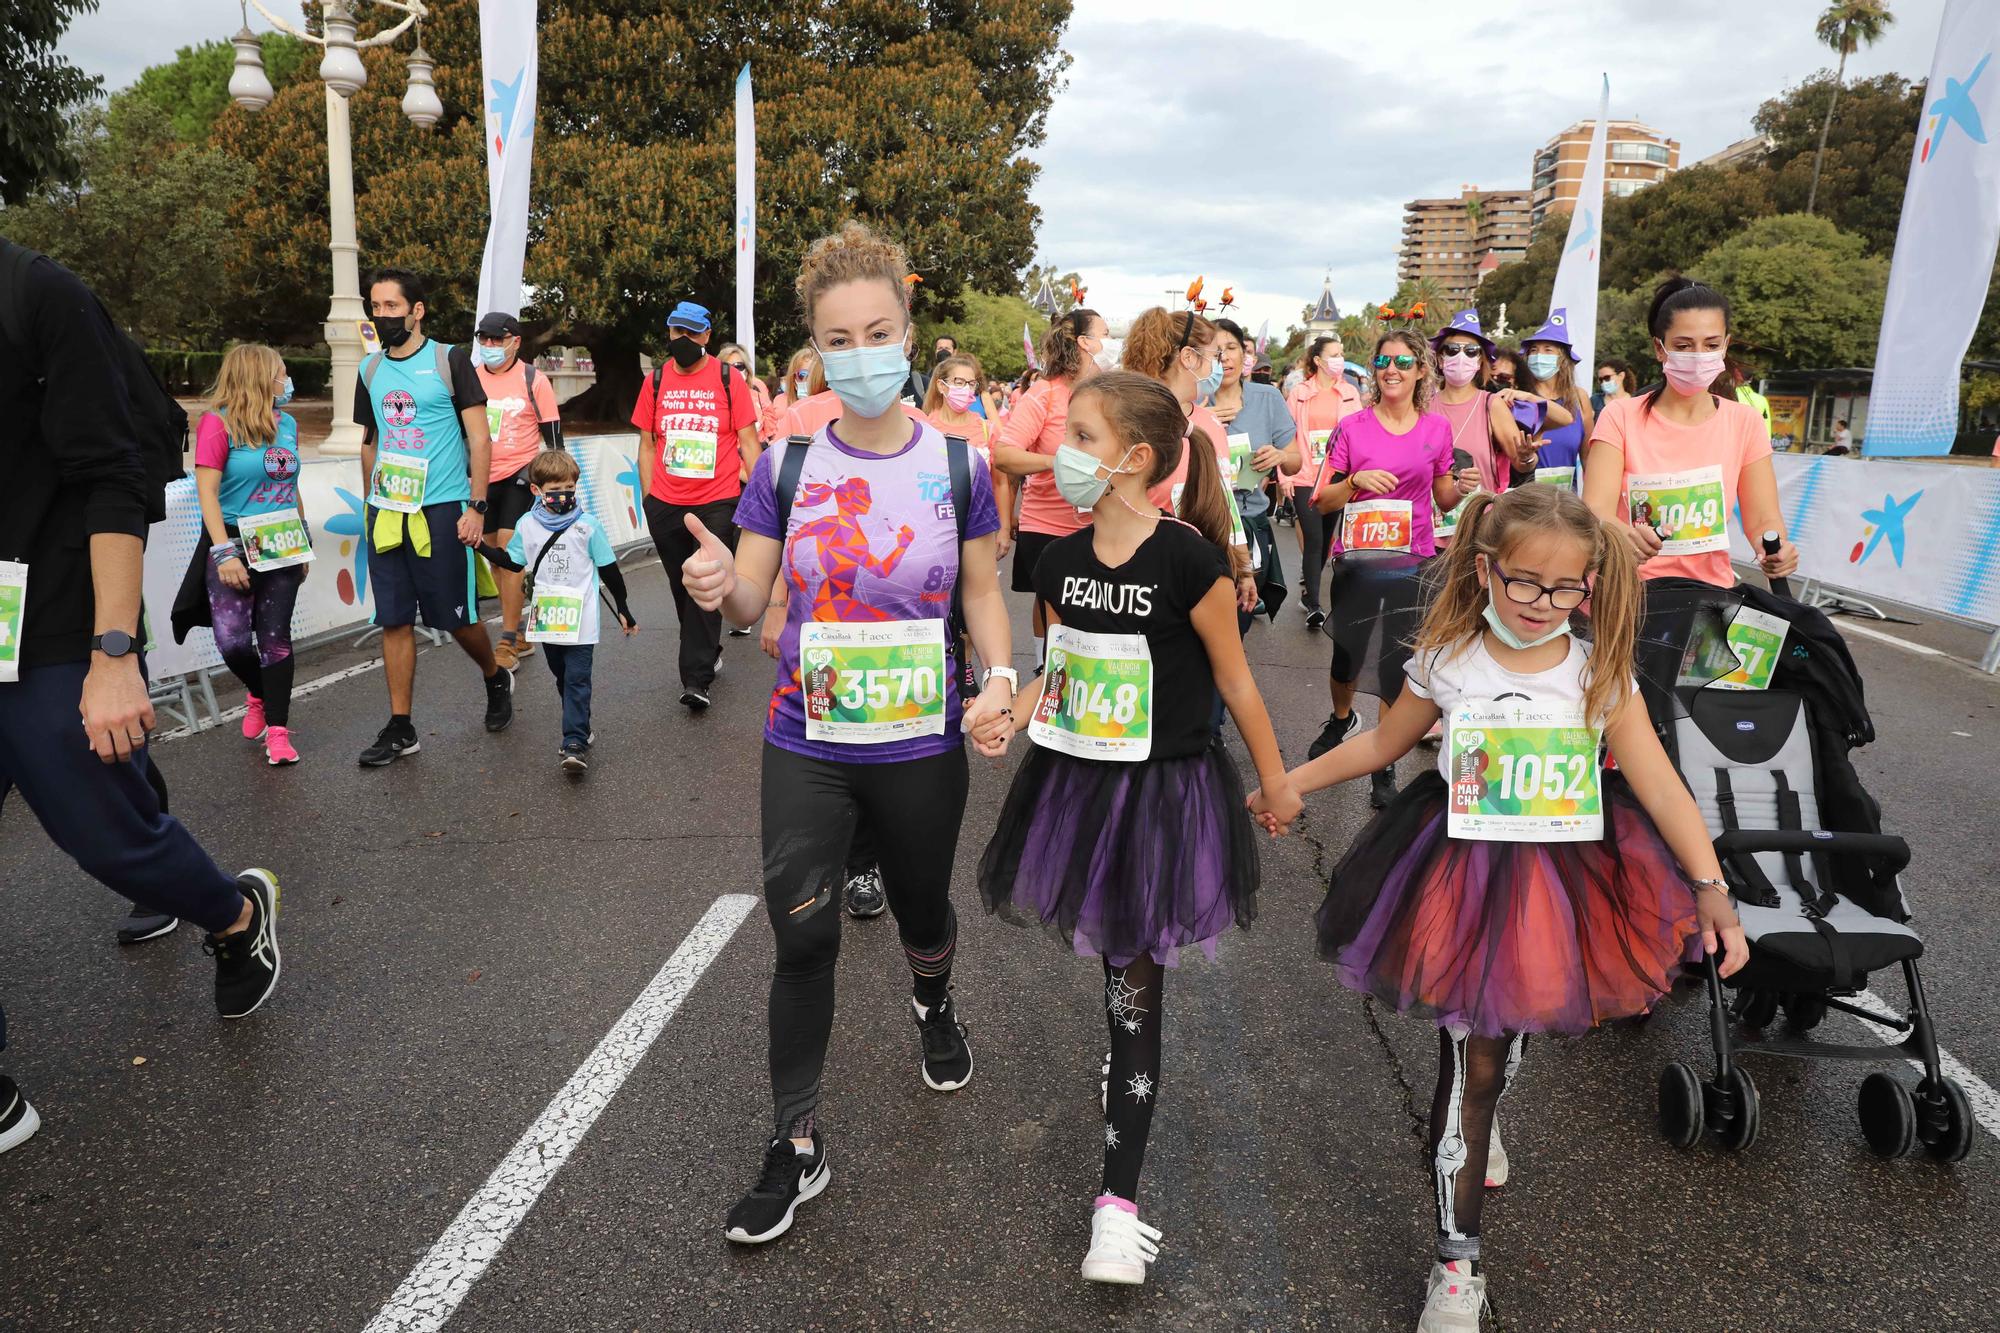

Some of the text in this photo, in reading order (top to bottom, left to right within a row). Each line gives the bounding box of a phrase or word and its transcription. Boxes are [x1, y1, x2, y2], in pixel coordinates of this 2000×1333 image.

[662, 400, 716, 411] Volta a Peu
[676, 447, 713, 465] 6426
[382, 473, 420, 497] 4881
[1657, 499, 1718, 532] 1049
[1362, 521, 1400, 542] 1793
[262, 529, 305, 553] 4882
[923, 566, 945, 591] 8
[1061, 576, 1153, 617] PEANUTS
[538, 606, 578, 625] 4880
[870, 633, 893, 641] aecc
[840, 666, 937, 710] 3570
[811, 696, 830, 707] MAR
[812, 704, 830, 715] CHA
[1044, 697, 1059, 708] MAR
[1066, 677, 1139, 725] 1048
[1041, 706, 1057, 718] CHA
[1472, 712, 1506, 721] CaixaBank
[1526, 713, 1553, 721] aecc
[1460, 766, 1471, 783] RUN
[1498, 754, 1587, 800] 1052
[1457, 784, 1479, 796] MAR
[1457, 795, 1479, 806] CHA
